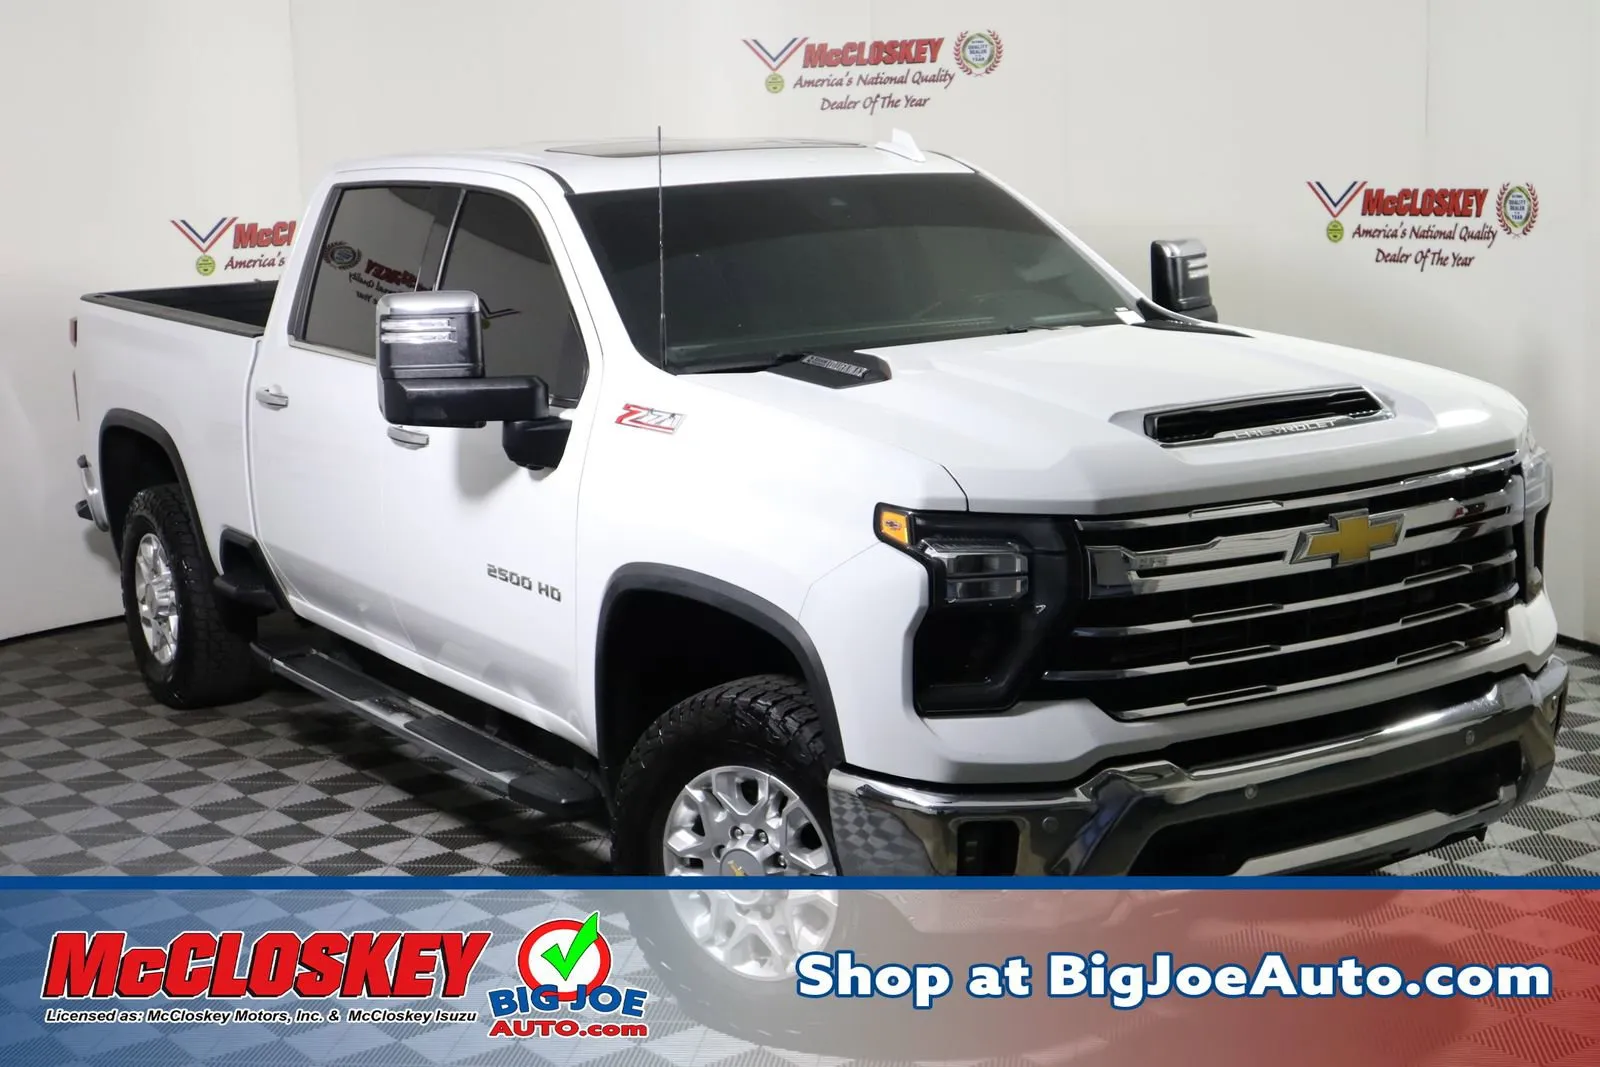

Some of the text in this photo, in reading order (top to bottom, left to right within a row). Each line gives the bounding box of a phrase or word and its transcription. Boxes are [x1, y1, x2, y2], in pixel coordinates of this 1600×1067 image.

[802, 37, 945, 69] McCLOSKEY
[793, 71, 853, 89] America's
[857, 71, 908, 87] National
[912, 67, 956, 89] Quality
[820, 93, 931, 116] Dealer Of The Year
[1361, 188, 1489, 218] McCLOSKEY
[1352, 222, 1407, 240] America's
[1409, 224, 1456, 241] National
[1459, 223, 1498, 249] Quality
[224, 251, 286, 271] America's
[1375, 246, 1476, 272] Dealer Of The Year
[1232, 419, 1337, 439] CHEVROLET
[486, 563, 562, 603] 2500 HD
